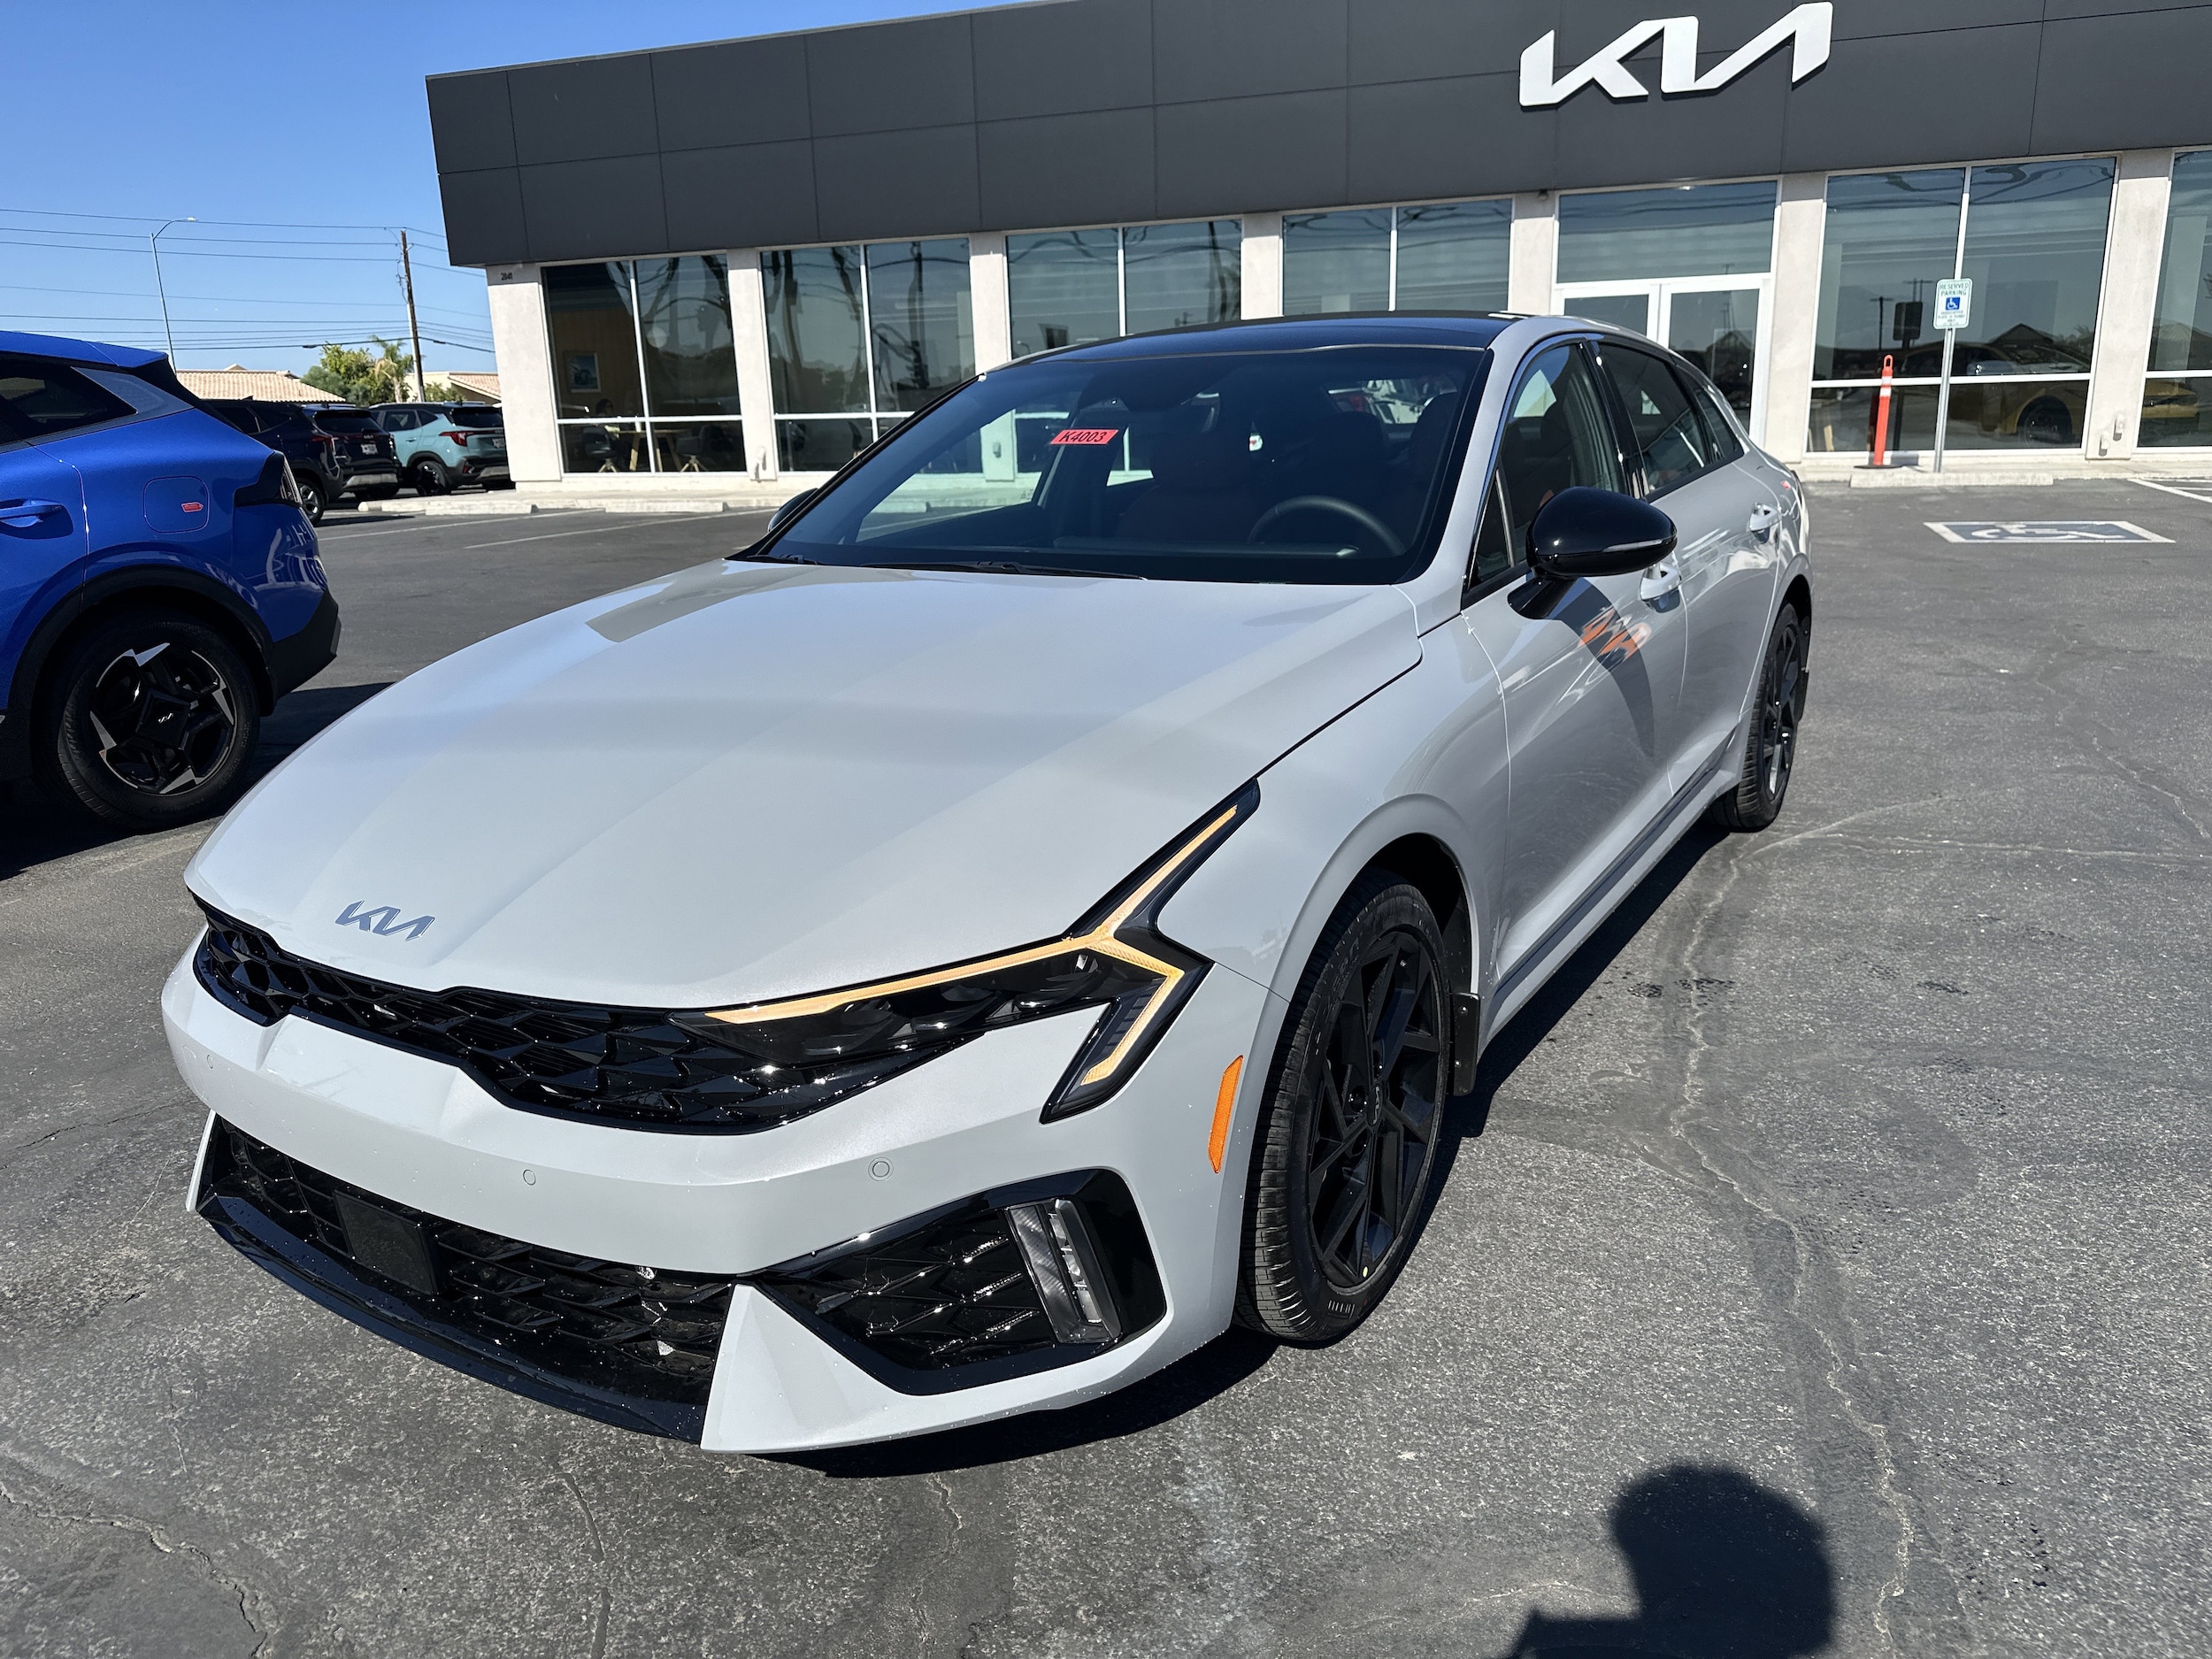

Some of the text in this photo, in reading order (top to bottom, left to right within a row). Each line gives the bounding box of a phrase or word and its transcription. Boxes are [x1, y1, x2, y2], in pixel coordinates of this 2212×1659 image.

[1519, 2, 1833, 106] KIA
[1058, 431, 1107, 442] K4003
[335, 900, 434, 941] KIA
